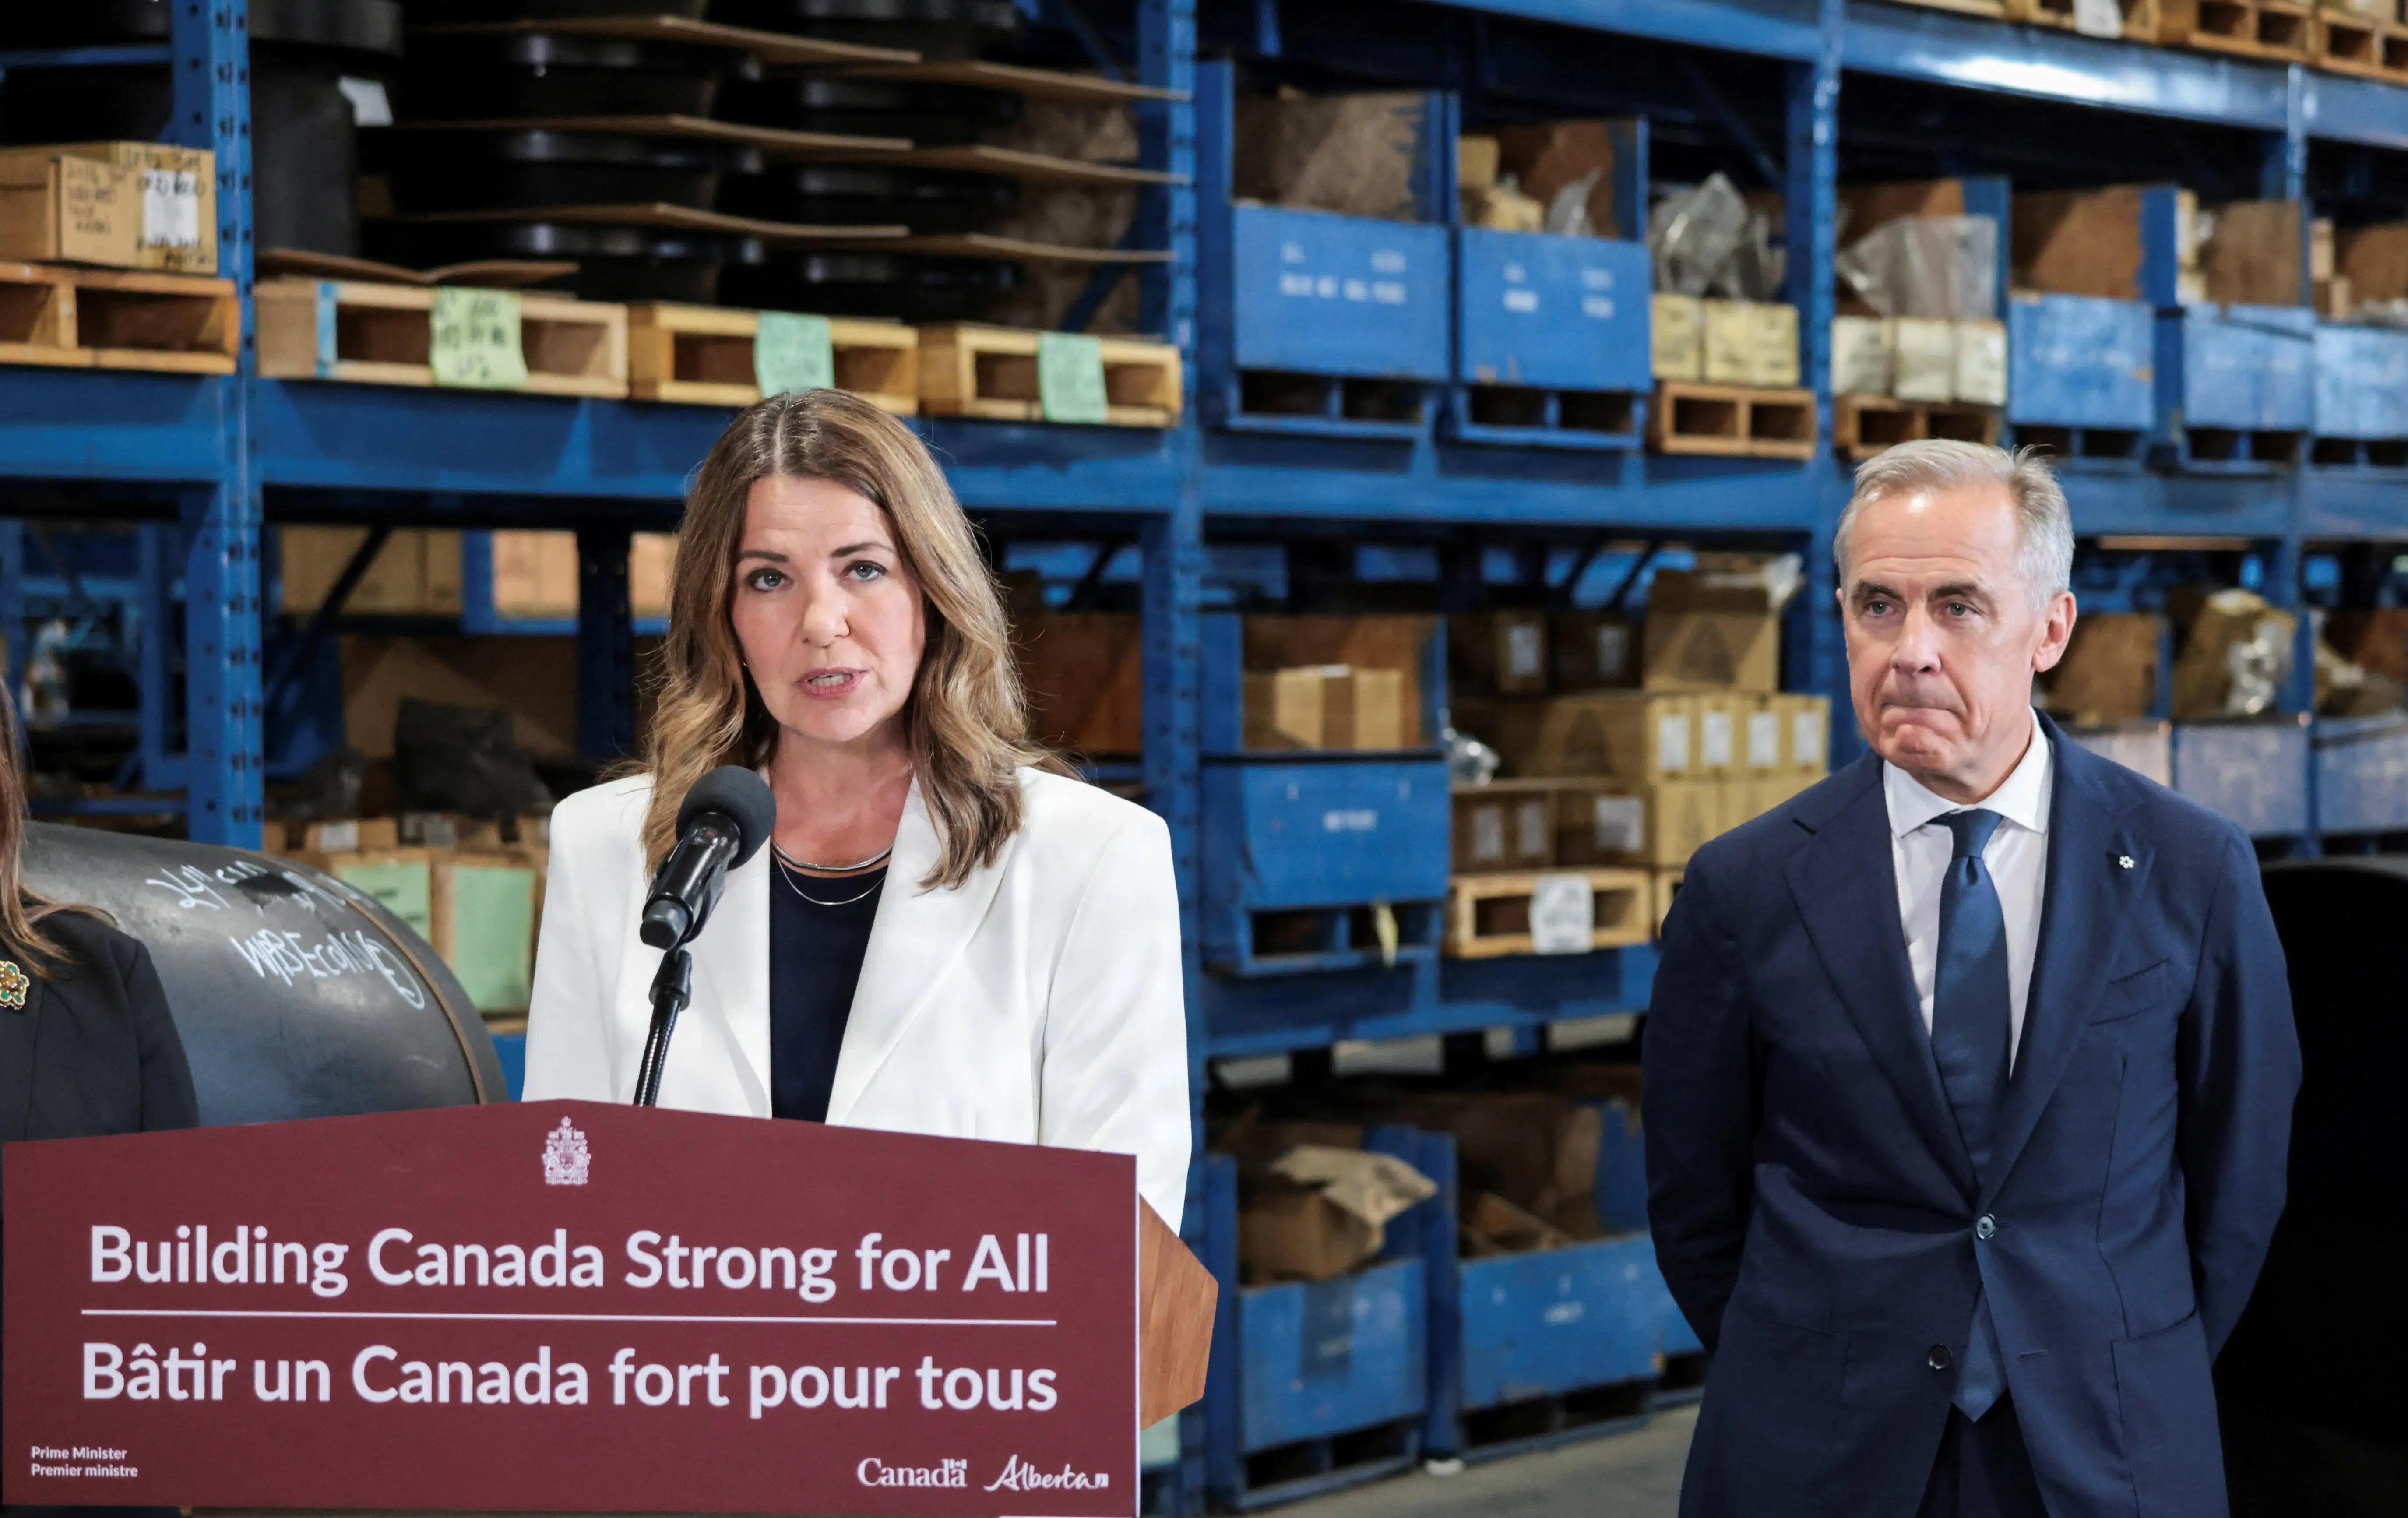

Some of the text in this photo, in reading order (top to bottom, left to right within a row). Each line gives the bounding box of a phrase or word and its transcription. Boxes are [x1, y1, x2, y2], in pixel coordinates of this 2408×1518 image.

[91, 1225, 1049, 1304] Building Canada Strong for All
[83, 1342, 1058, 1420] Bâtir un Canada fort pour tous
[31, 1446, 128, 1460] Prime Minister
[31, 1463, 139, 1478] Premier ministre
[857, 1454, 1100, 1492] Canada Alberta
